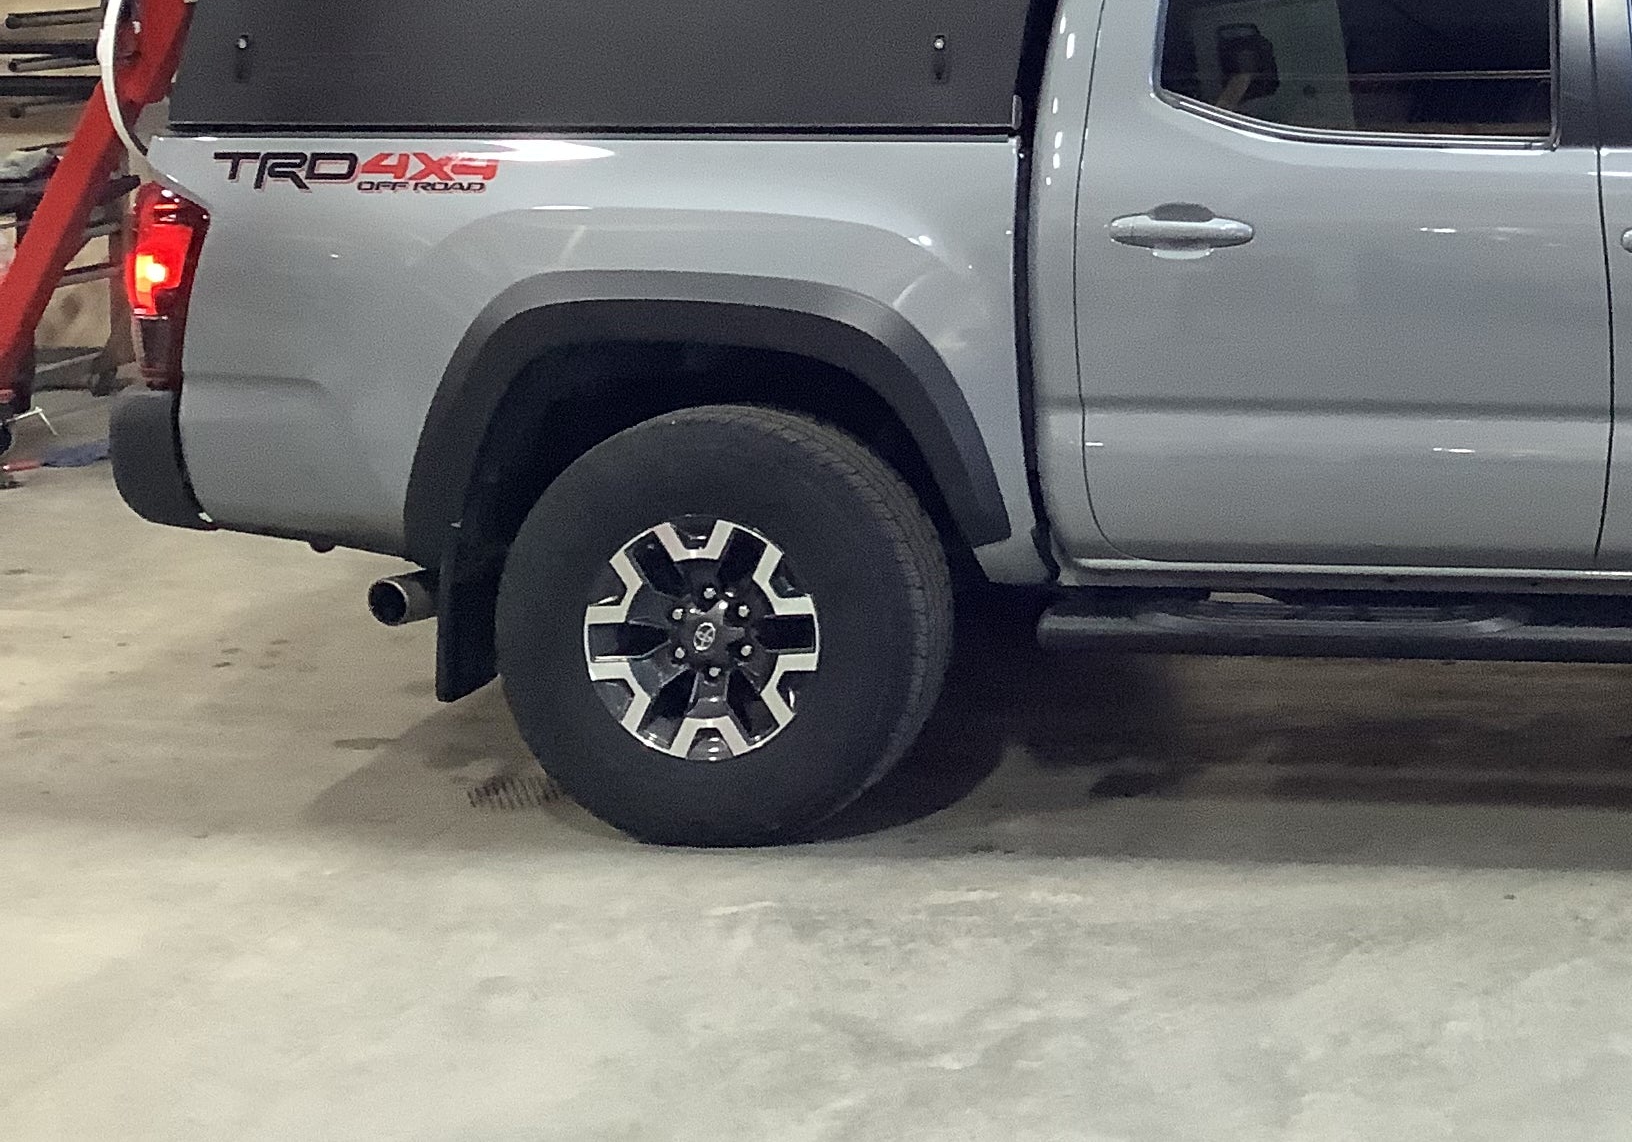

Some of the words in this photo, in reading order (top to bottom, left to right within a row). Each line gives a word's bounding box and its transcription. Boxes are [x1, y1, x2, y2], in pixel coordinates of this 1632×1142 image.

[213, 152, 359, 191] TRD
[357, 181, 409, 192] OFF
[413, 181, 486, 192] ROAD
